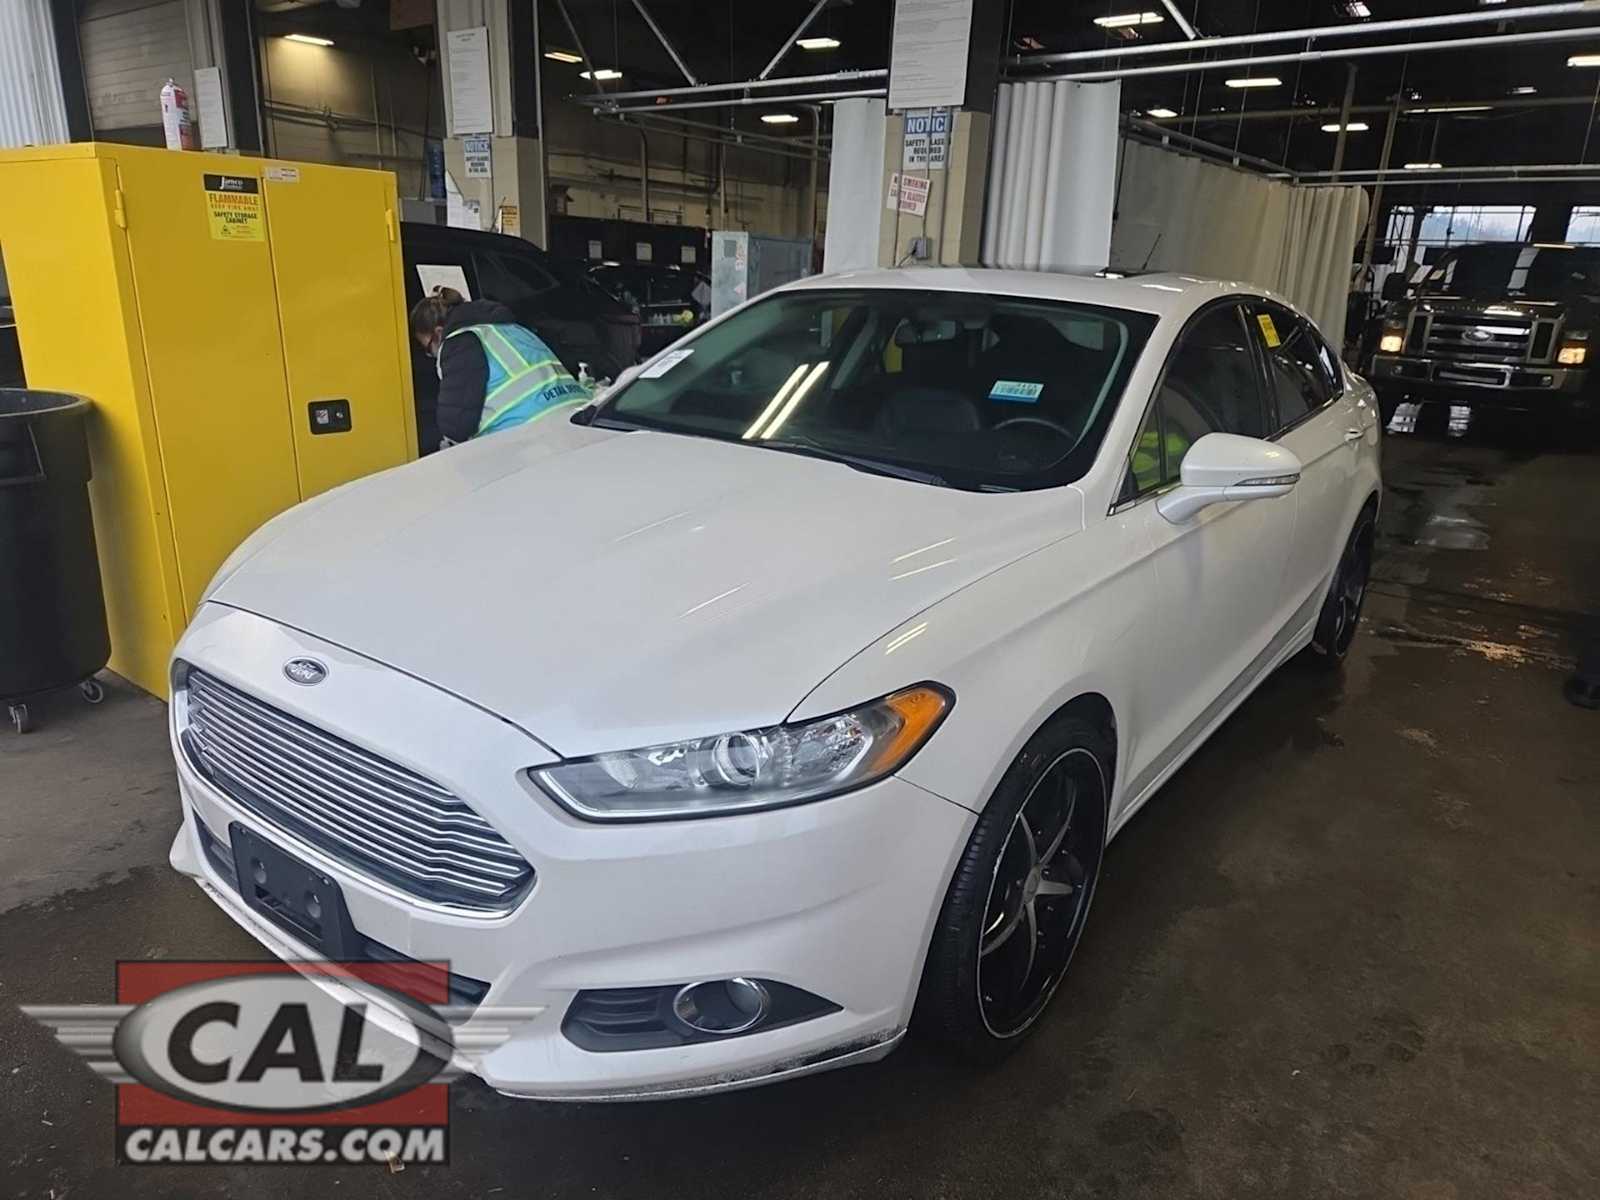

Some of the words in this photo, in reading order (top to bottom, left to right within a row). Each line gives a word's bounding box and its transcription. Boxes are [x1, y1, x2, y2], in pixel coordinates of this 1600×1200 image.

[907, 117, 944, 133] NOTIC
[905, 138, 925, 147] SAFETY
[913, 146, 942, 155] REQURED
[208, 192, 258, 205] FLAMMABLE
